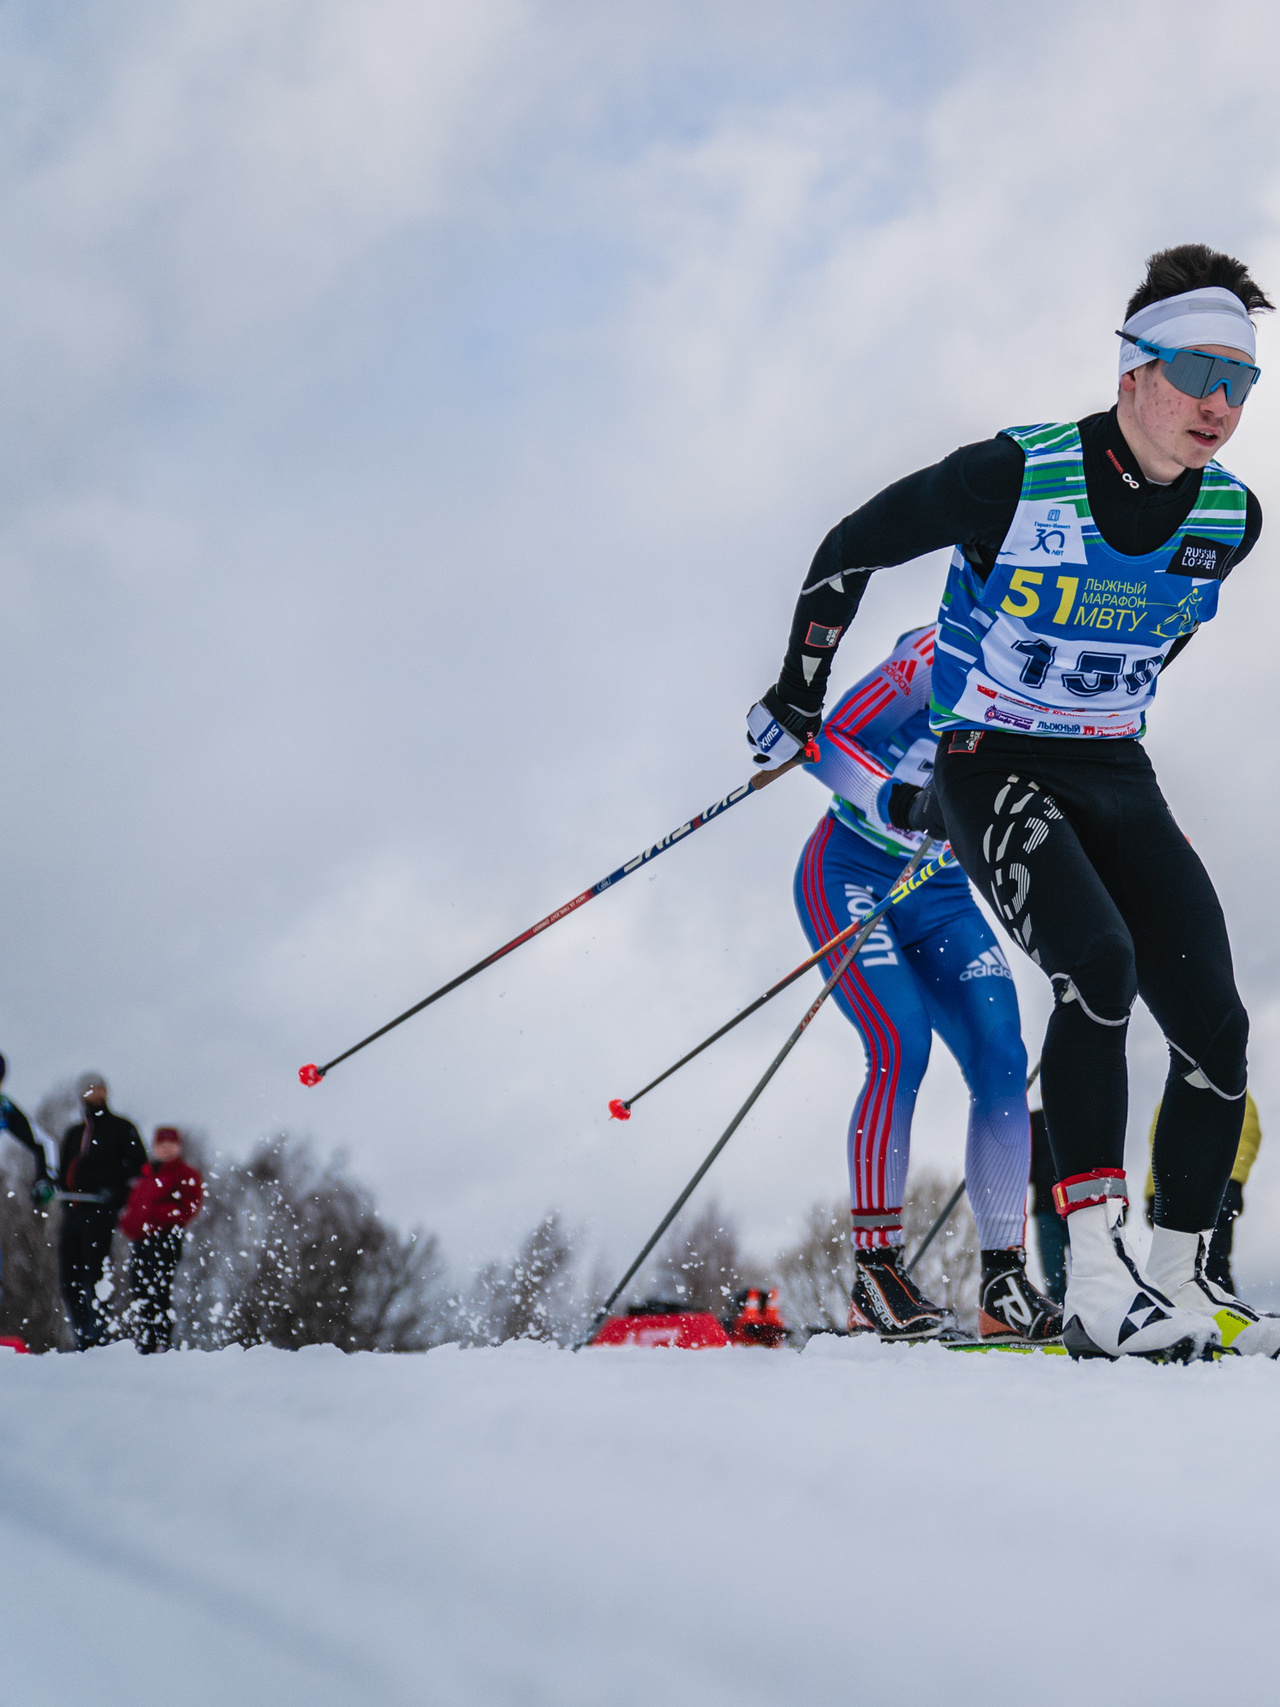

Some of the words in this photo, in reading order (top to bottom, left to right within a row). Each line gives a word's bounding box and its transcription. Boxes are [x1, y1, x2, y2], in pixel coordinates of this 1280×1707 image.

[1000, 568, 1080, 626] 51
[1084, 577, 1148, 595] ЛЫЖНЫЙ
[1081, 592, 1147, 609] МАРАФОН
[1073, 606, 1148, 632] МВТУ
[881, 664, 912, 697] adidas
[1036, 720, 1081, 734] ЛЫЖНЫЙ
[859, 1273, 896, 1331] ROSSIGNOL
